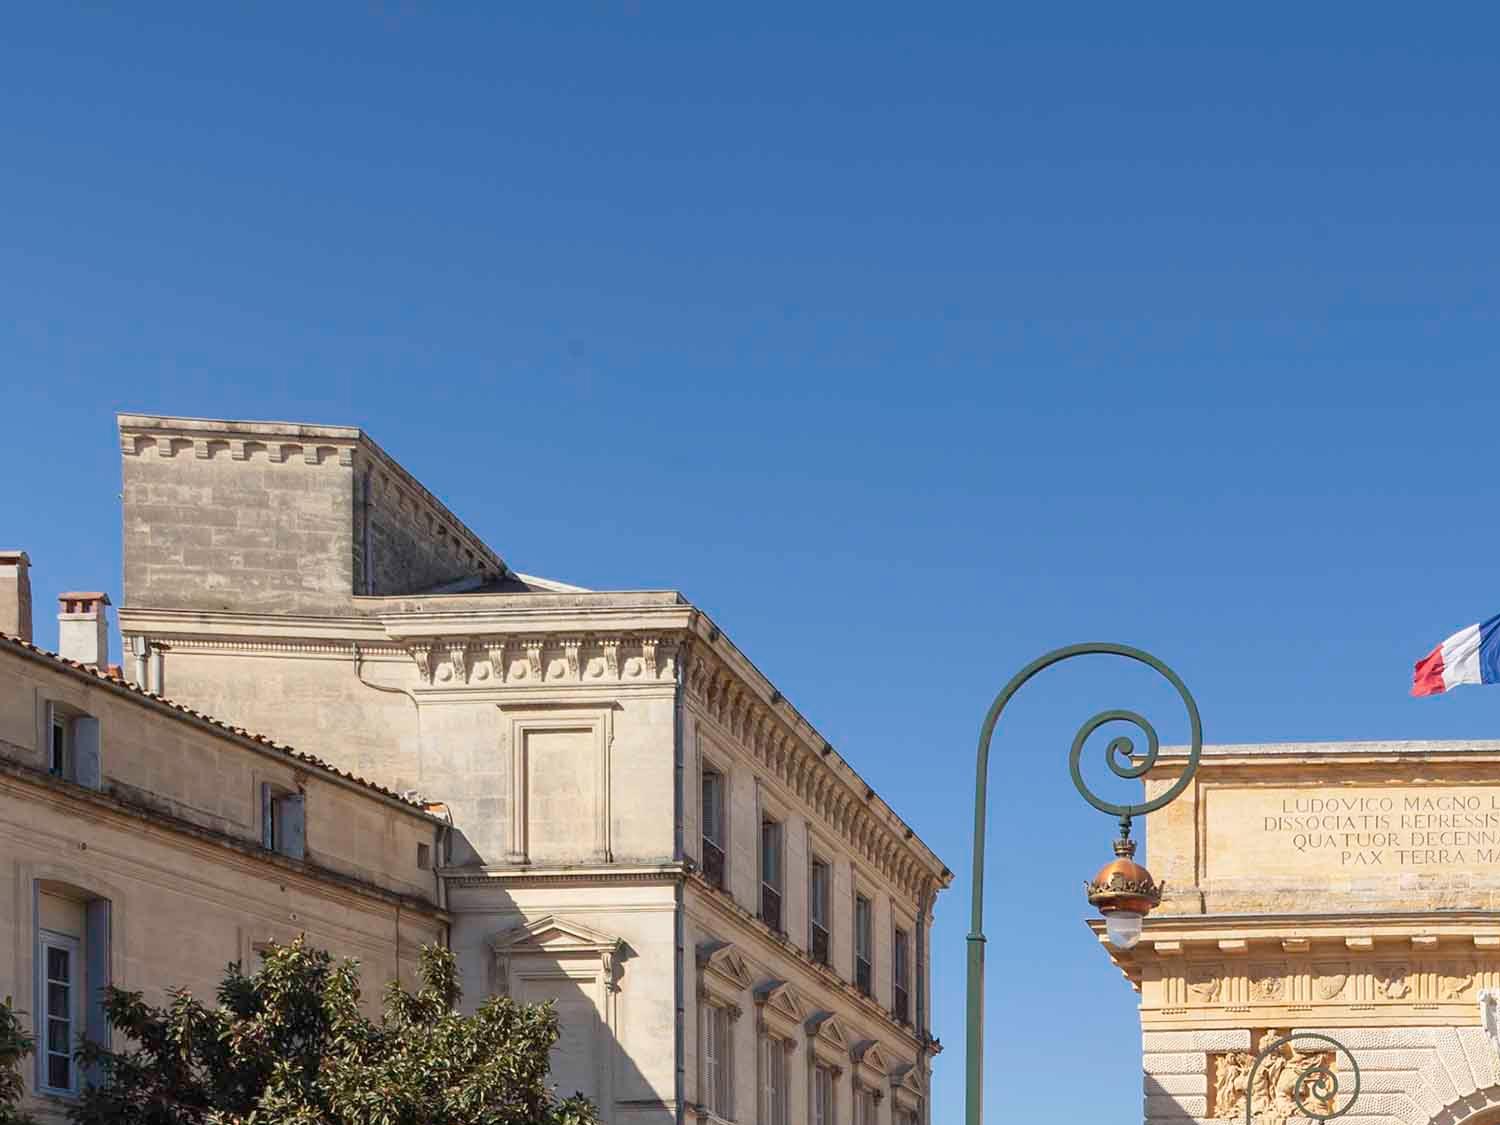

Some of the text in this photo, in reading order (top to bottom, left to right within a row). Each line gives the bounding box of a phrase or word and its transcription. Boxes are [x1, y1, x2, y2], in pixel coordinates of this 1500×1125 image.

[1282, 797, 1393, 814] LUDOVICO
[1404, 795, 1481, 812] MAGNO
[1264, 815, 1390, 832] DISSOCIATIS
[1401, 813, 1498, 830] REPRESSIS
[1293, 833, 1400, 852] QUATUOR
[1341, 850, 1384, 865] PAX
[1397, 849, 1465, 865] TERRA
